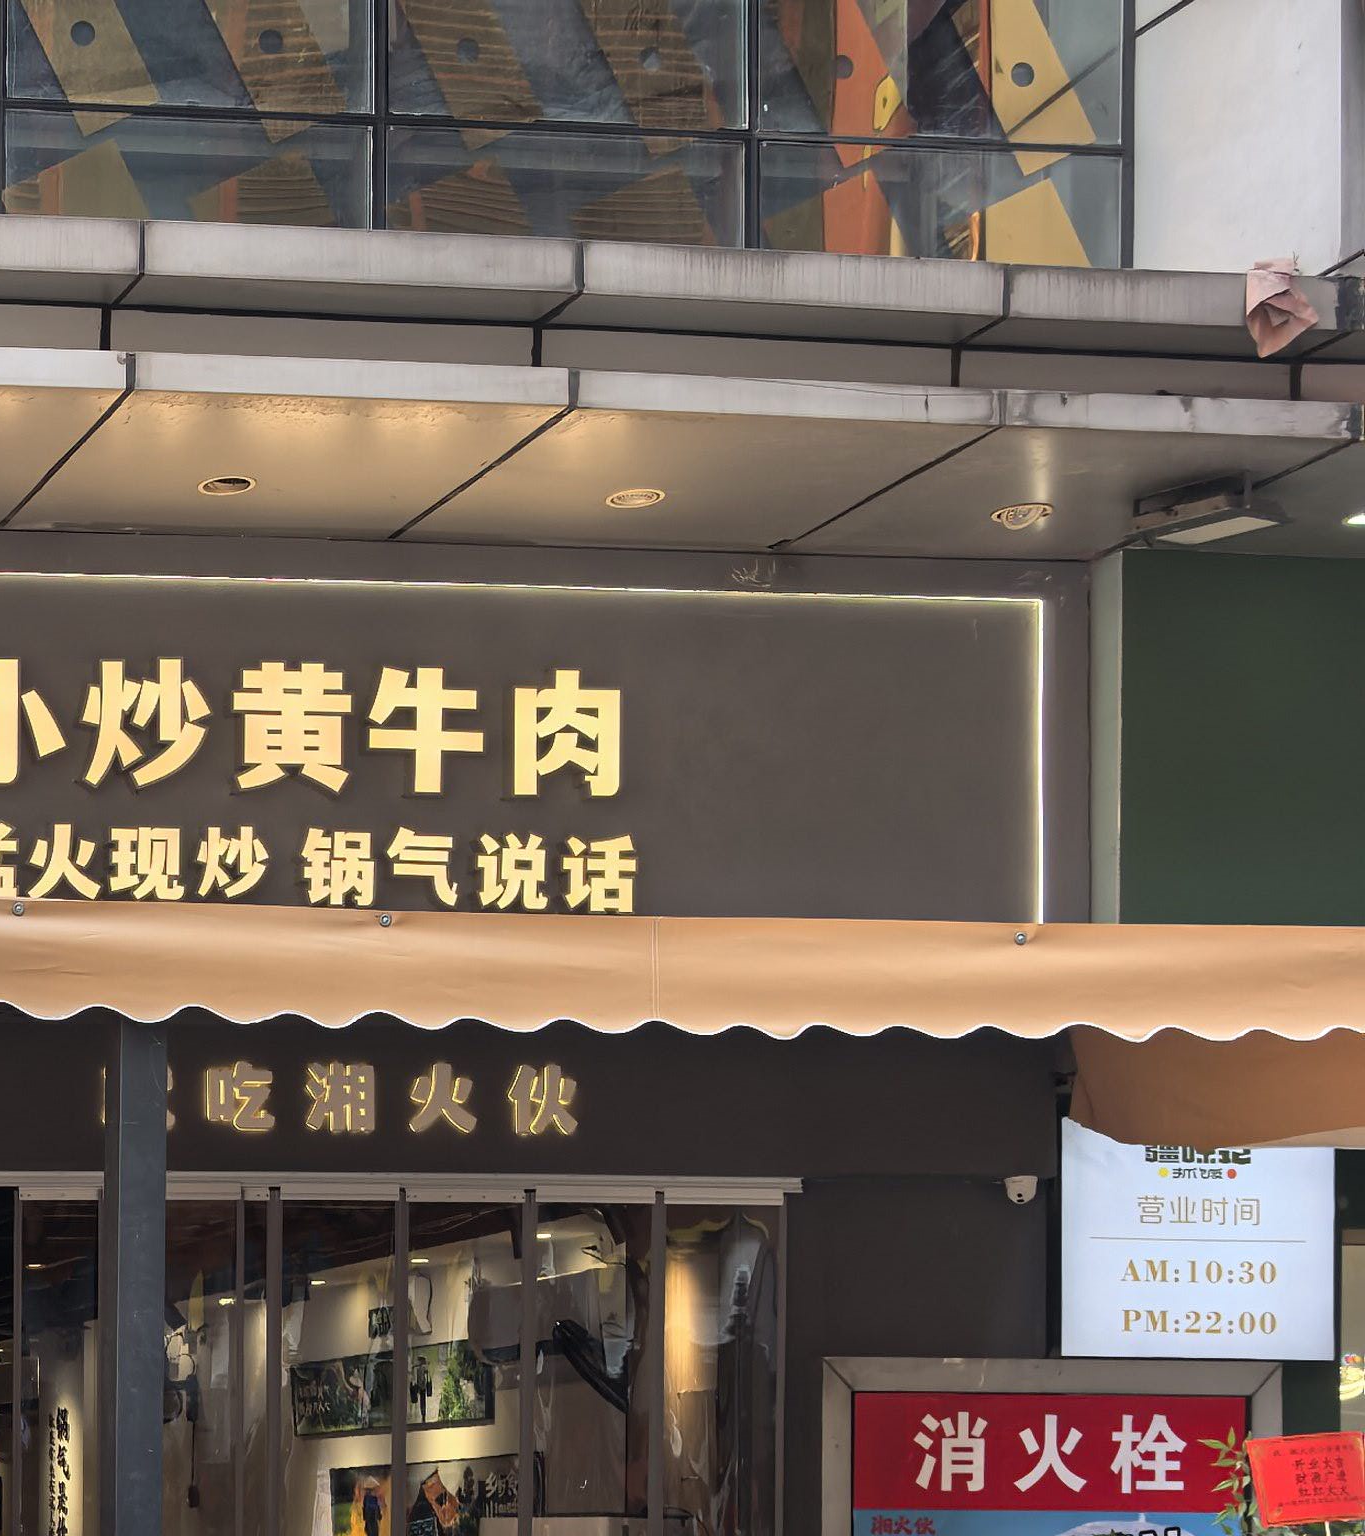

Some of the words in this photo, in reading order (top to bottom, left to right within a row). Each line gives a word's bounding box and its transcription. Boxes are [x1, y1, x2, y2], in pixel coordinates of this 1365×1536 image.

[302, 826, 637, 914] 锅气说话
[1137, 1196, 1261, 1226] 营业时间
[1121, 1258, 1278, 1286] AM:10:30
[1121, 1308, 1278, 1336] PM:22:00
[913, 1411, 1188, 1494] 消火栓
[871, 1516, 936, 1536] 湘火伙
